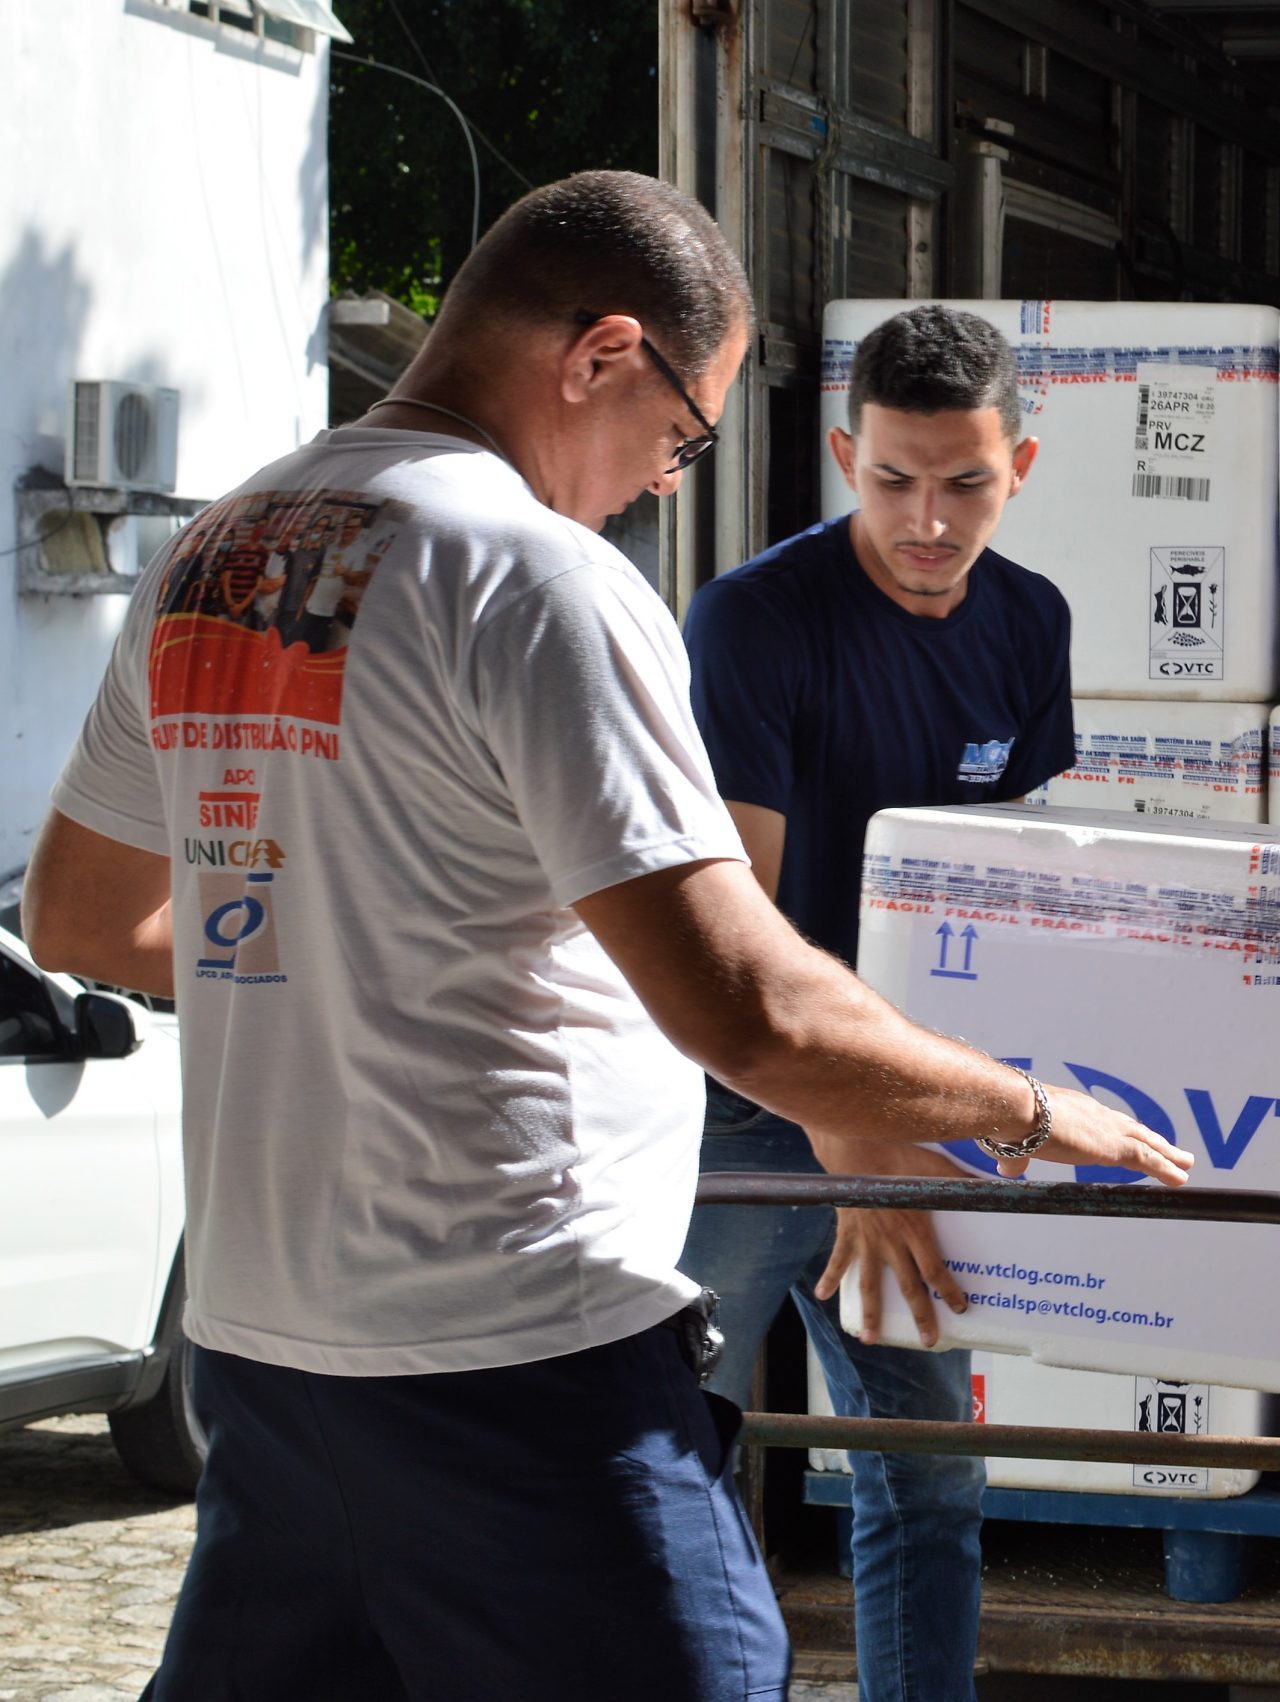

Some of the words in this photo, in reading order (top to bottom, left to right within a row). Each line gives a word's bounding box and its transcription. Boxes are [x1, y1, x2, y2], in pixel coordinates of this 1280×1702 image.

[1157, 391, 1198, 401] 39747304
[1150, 400, 1190, 412] 26APR
[1148, 420, 1172, 430] PRV
[1154, 431, 1205, 452] MCZ
[1137, 460, 1146, 471] R
[1184, 663, 1214, 673] VTC
[301, 728, 338, 760] PNI
[1153, 806, 1194, 818] 39747304
[944, 907, 1019, 925] FRÁGIL
[1030, 917, 1105, 935] FRÁGIL
[1169, 1474, 1198, 1484] VTC
